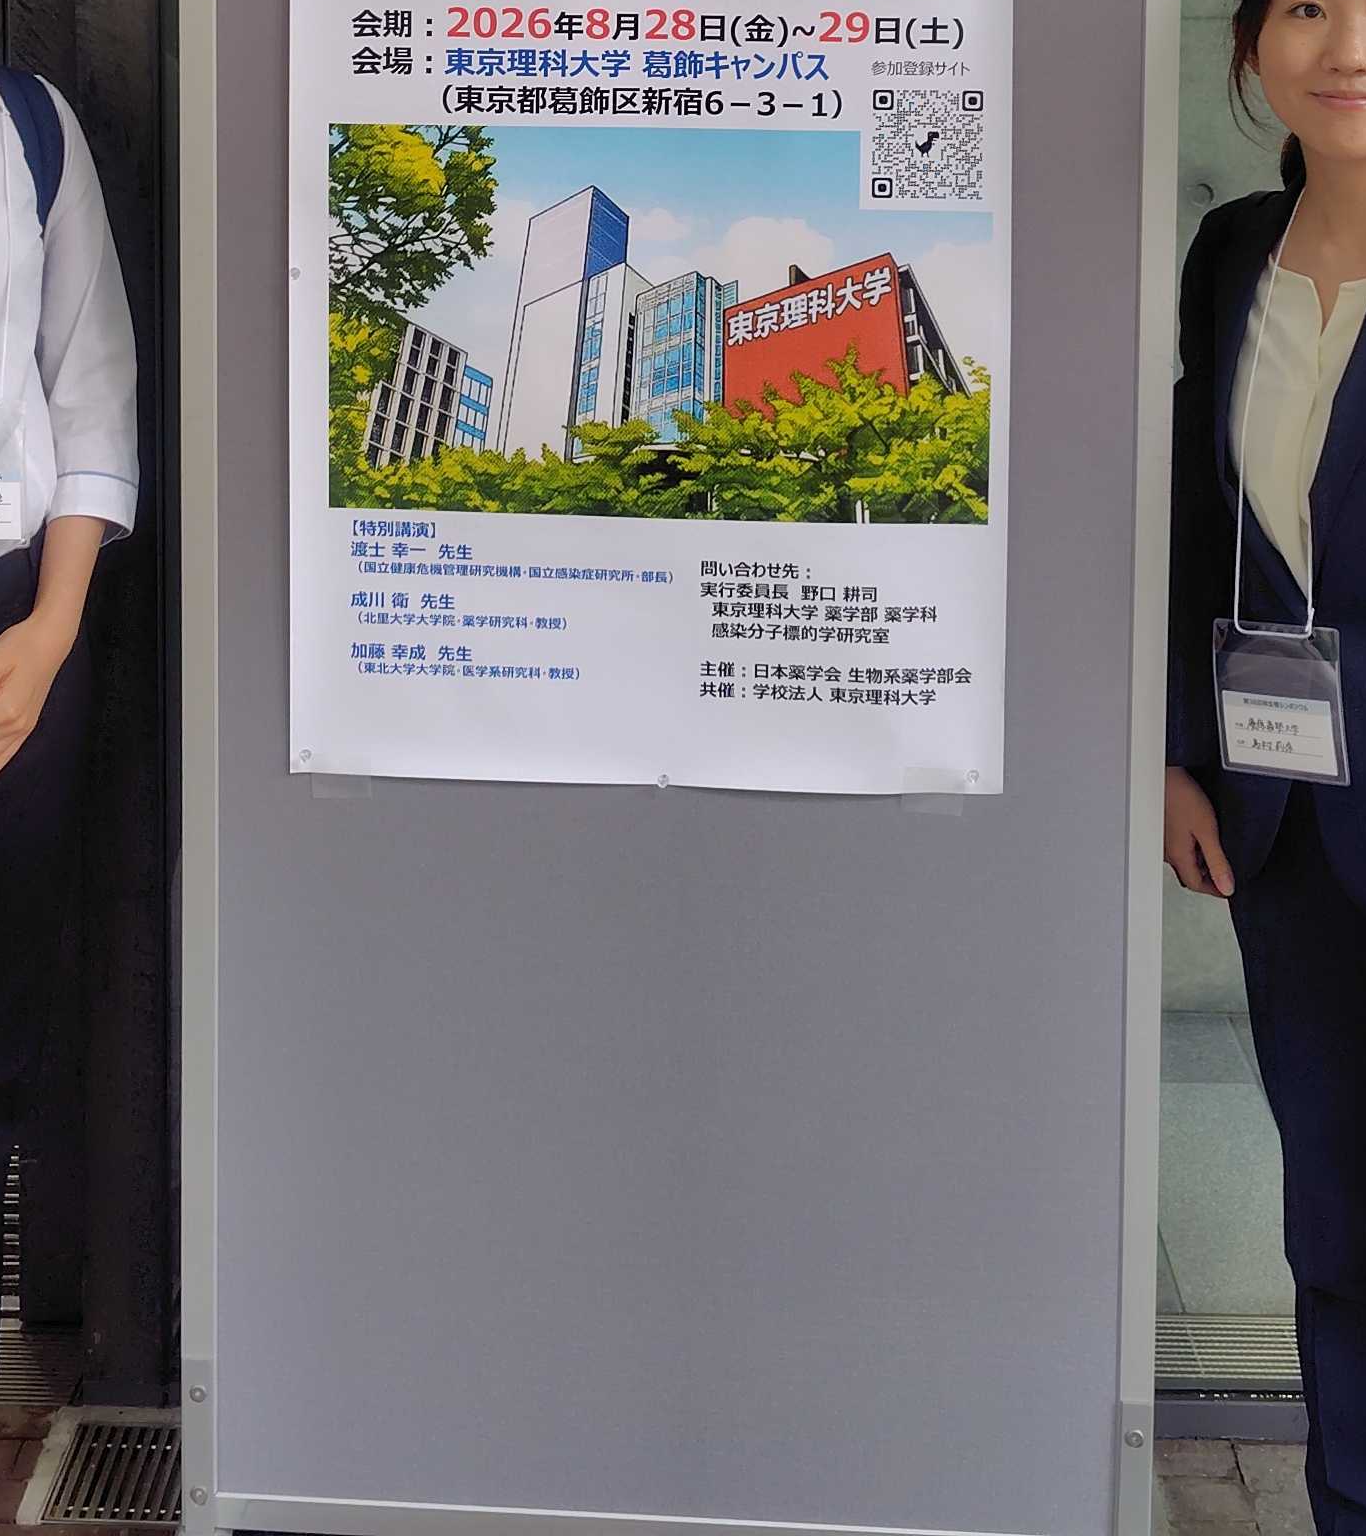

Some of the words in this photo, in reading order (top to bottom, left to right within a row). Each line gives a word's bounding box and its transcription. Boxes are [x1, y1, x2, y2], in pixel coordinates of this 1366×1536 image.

[642, 50, 830, 81] 葛飾キャンパス
[871, 60, 971, 77] 参加登録サイト
[727, 267, 892, 347] 東京理科大学
[353, 519, 436, 539] 【特別講演】
[351, 541, 385, 558] 渡士
[392, 542, 426, 559] 幸一
[438, 544, 473, 560] 先生
[351, 591, 385, 608] 成川
[420, 593, 455, 610] 先生
[700, 582, 789, 600] 実行委員長
[801, 585, 836, 602] 野口
[842, 586, 878, 603] 耕司
[712, 602, 819, 620] 東京理科大学
[824, 605, 878, 623] 薬学部
[884, 606, 937, 623] 薬学科
[711, 623, 890, 644] 感染分子標的学研究室
[351, 642, 385, 659] 加藤
[391, 644, 426, 660] 幸成
[438, 646, 472, 662] 先生
[848, 667, 972, 685] 生物系薬学部会
[829, 687, 937, 706] 東京理科大学
